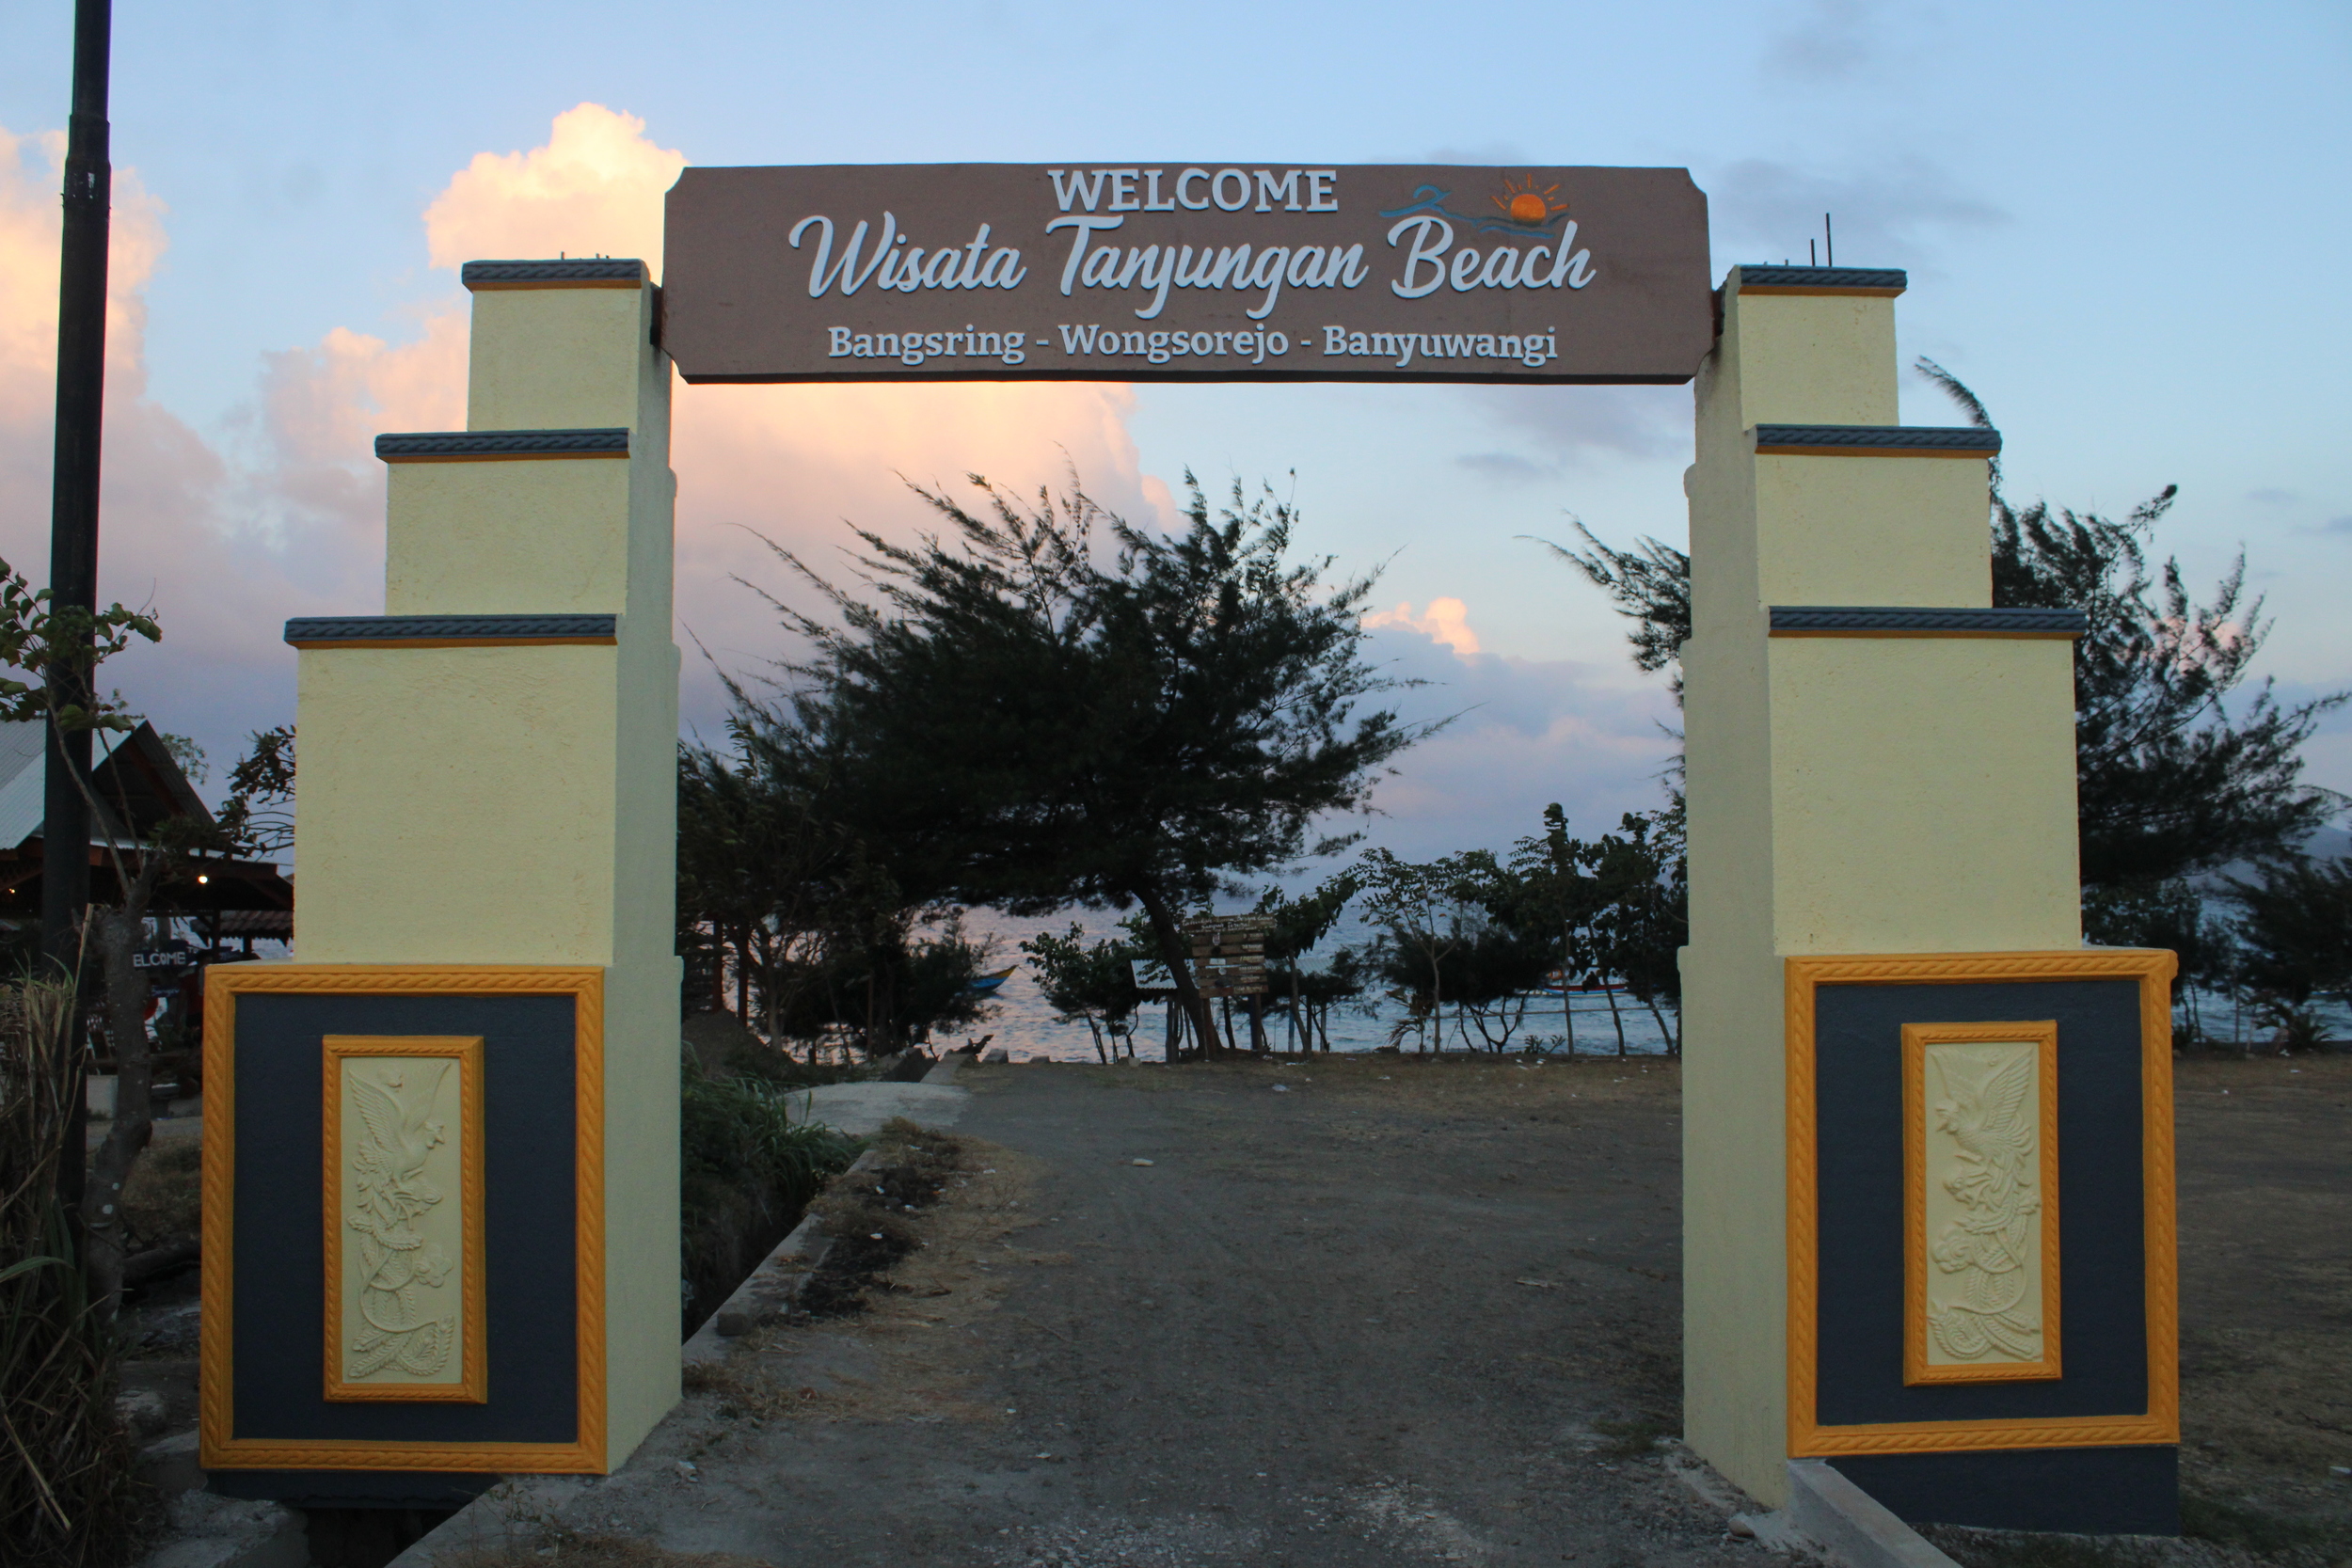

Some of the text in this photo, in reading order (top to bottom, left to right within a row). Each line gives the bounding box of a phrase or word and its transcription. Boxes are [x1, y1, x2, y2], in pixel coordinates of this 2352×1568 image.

[1047, 168, 1339, 213] WELCOME
[788, 211, 1027, 298] Wisata
[1387, 215, 1597, 299] Beach
[827, 324, 1025, 366] Bangsring
[1057, 323, 1290, 365] Wongsorejo
[1322, 325, 1559, 368] Banyuwangi
[133, 951, 186, 967] ELCOME
